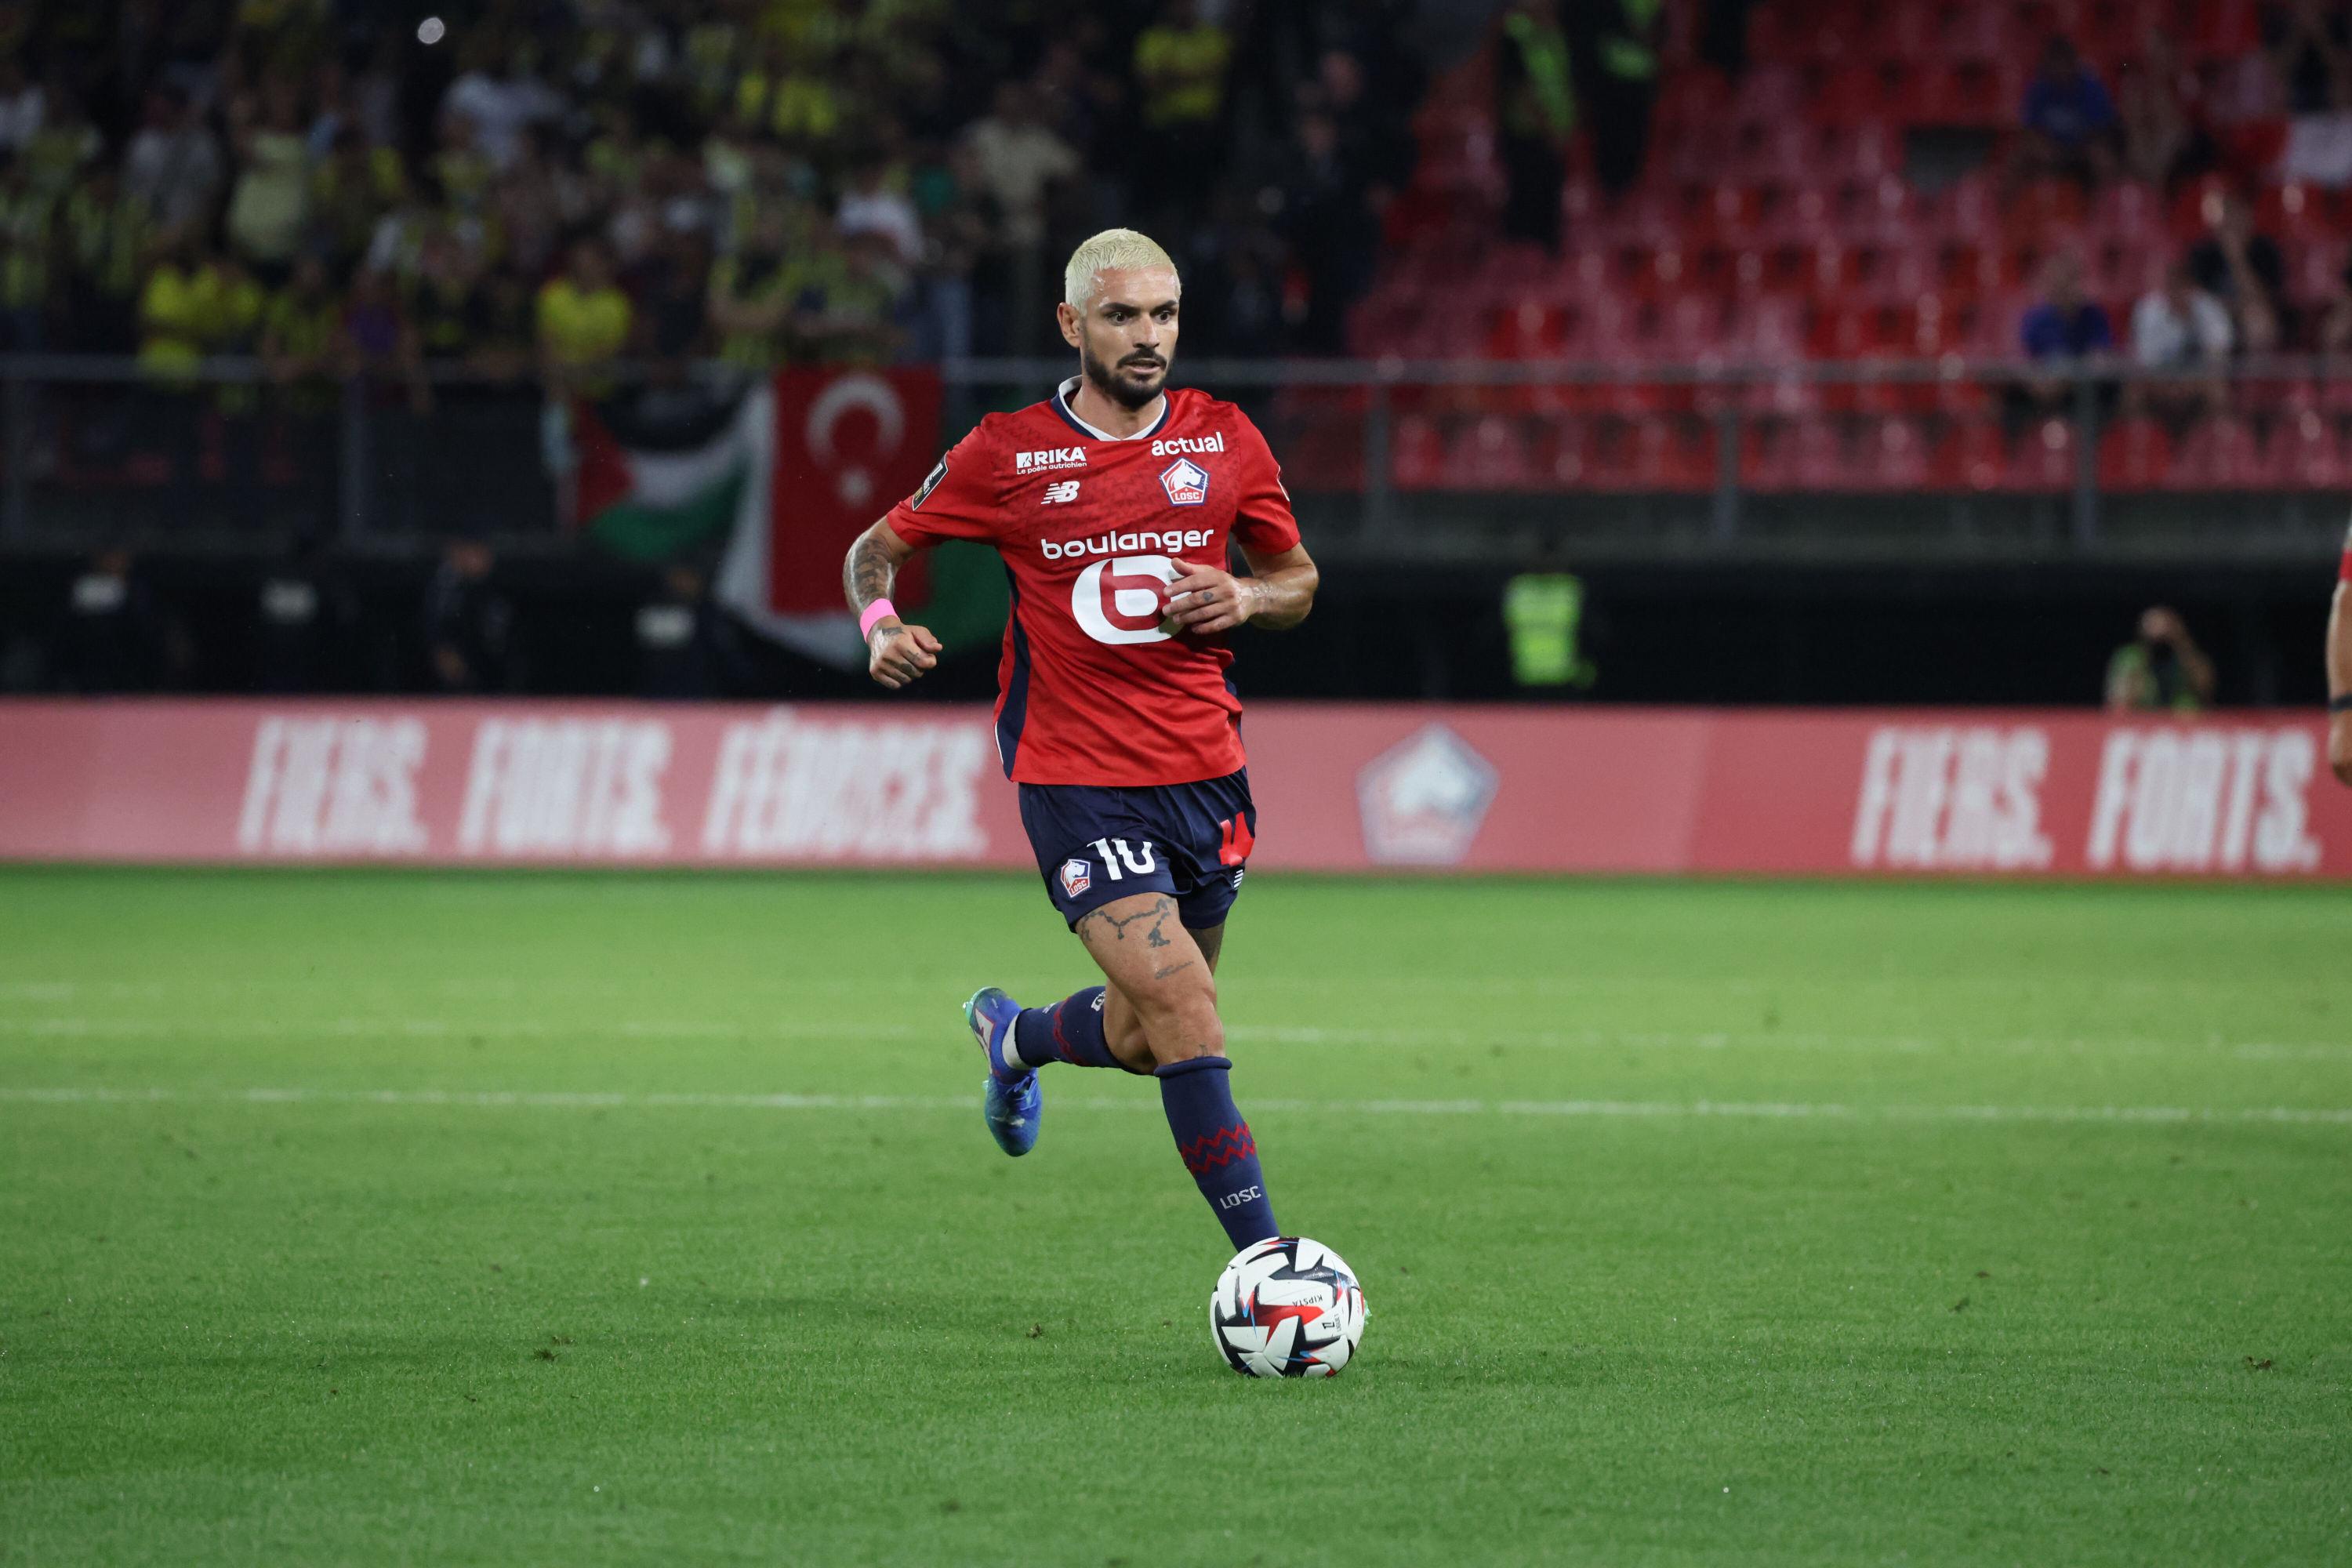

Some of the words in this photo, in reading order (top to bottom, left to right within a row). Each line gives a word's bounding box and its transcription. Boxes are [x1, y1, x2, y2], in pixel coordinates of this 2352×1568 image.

[1152, 432, 1224, 456] actual
[1034, 447, 1086, 465] RIKA
[1028, 464, 1047, 474] poêle
[1040, 481, 1080, 504] NB
[1175, 492, 1200, 501] LOSC
[1041, 529, 1214, 560] boulanger
[1070, 880, 1087, 894] LOSC
[1220, 1185, 1261, 1209] LOSC
[1292, 1294, 1323, 1307] KIPSTA
